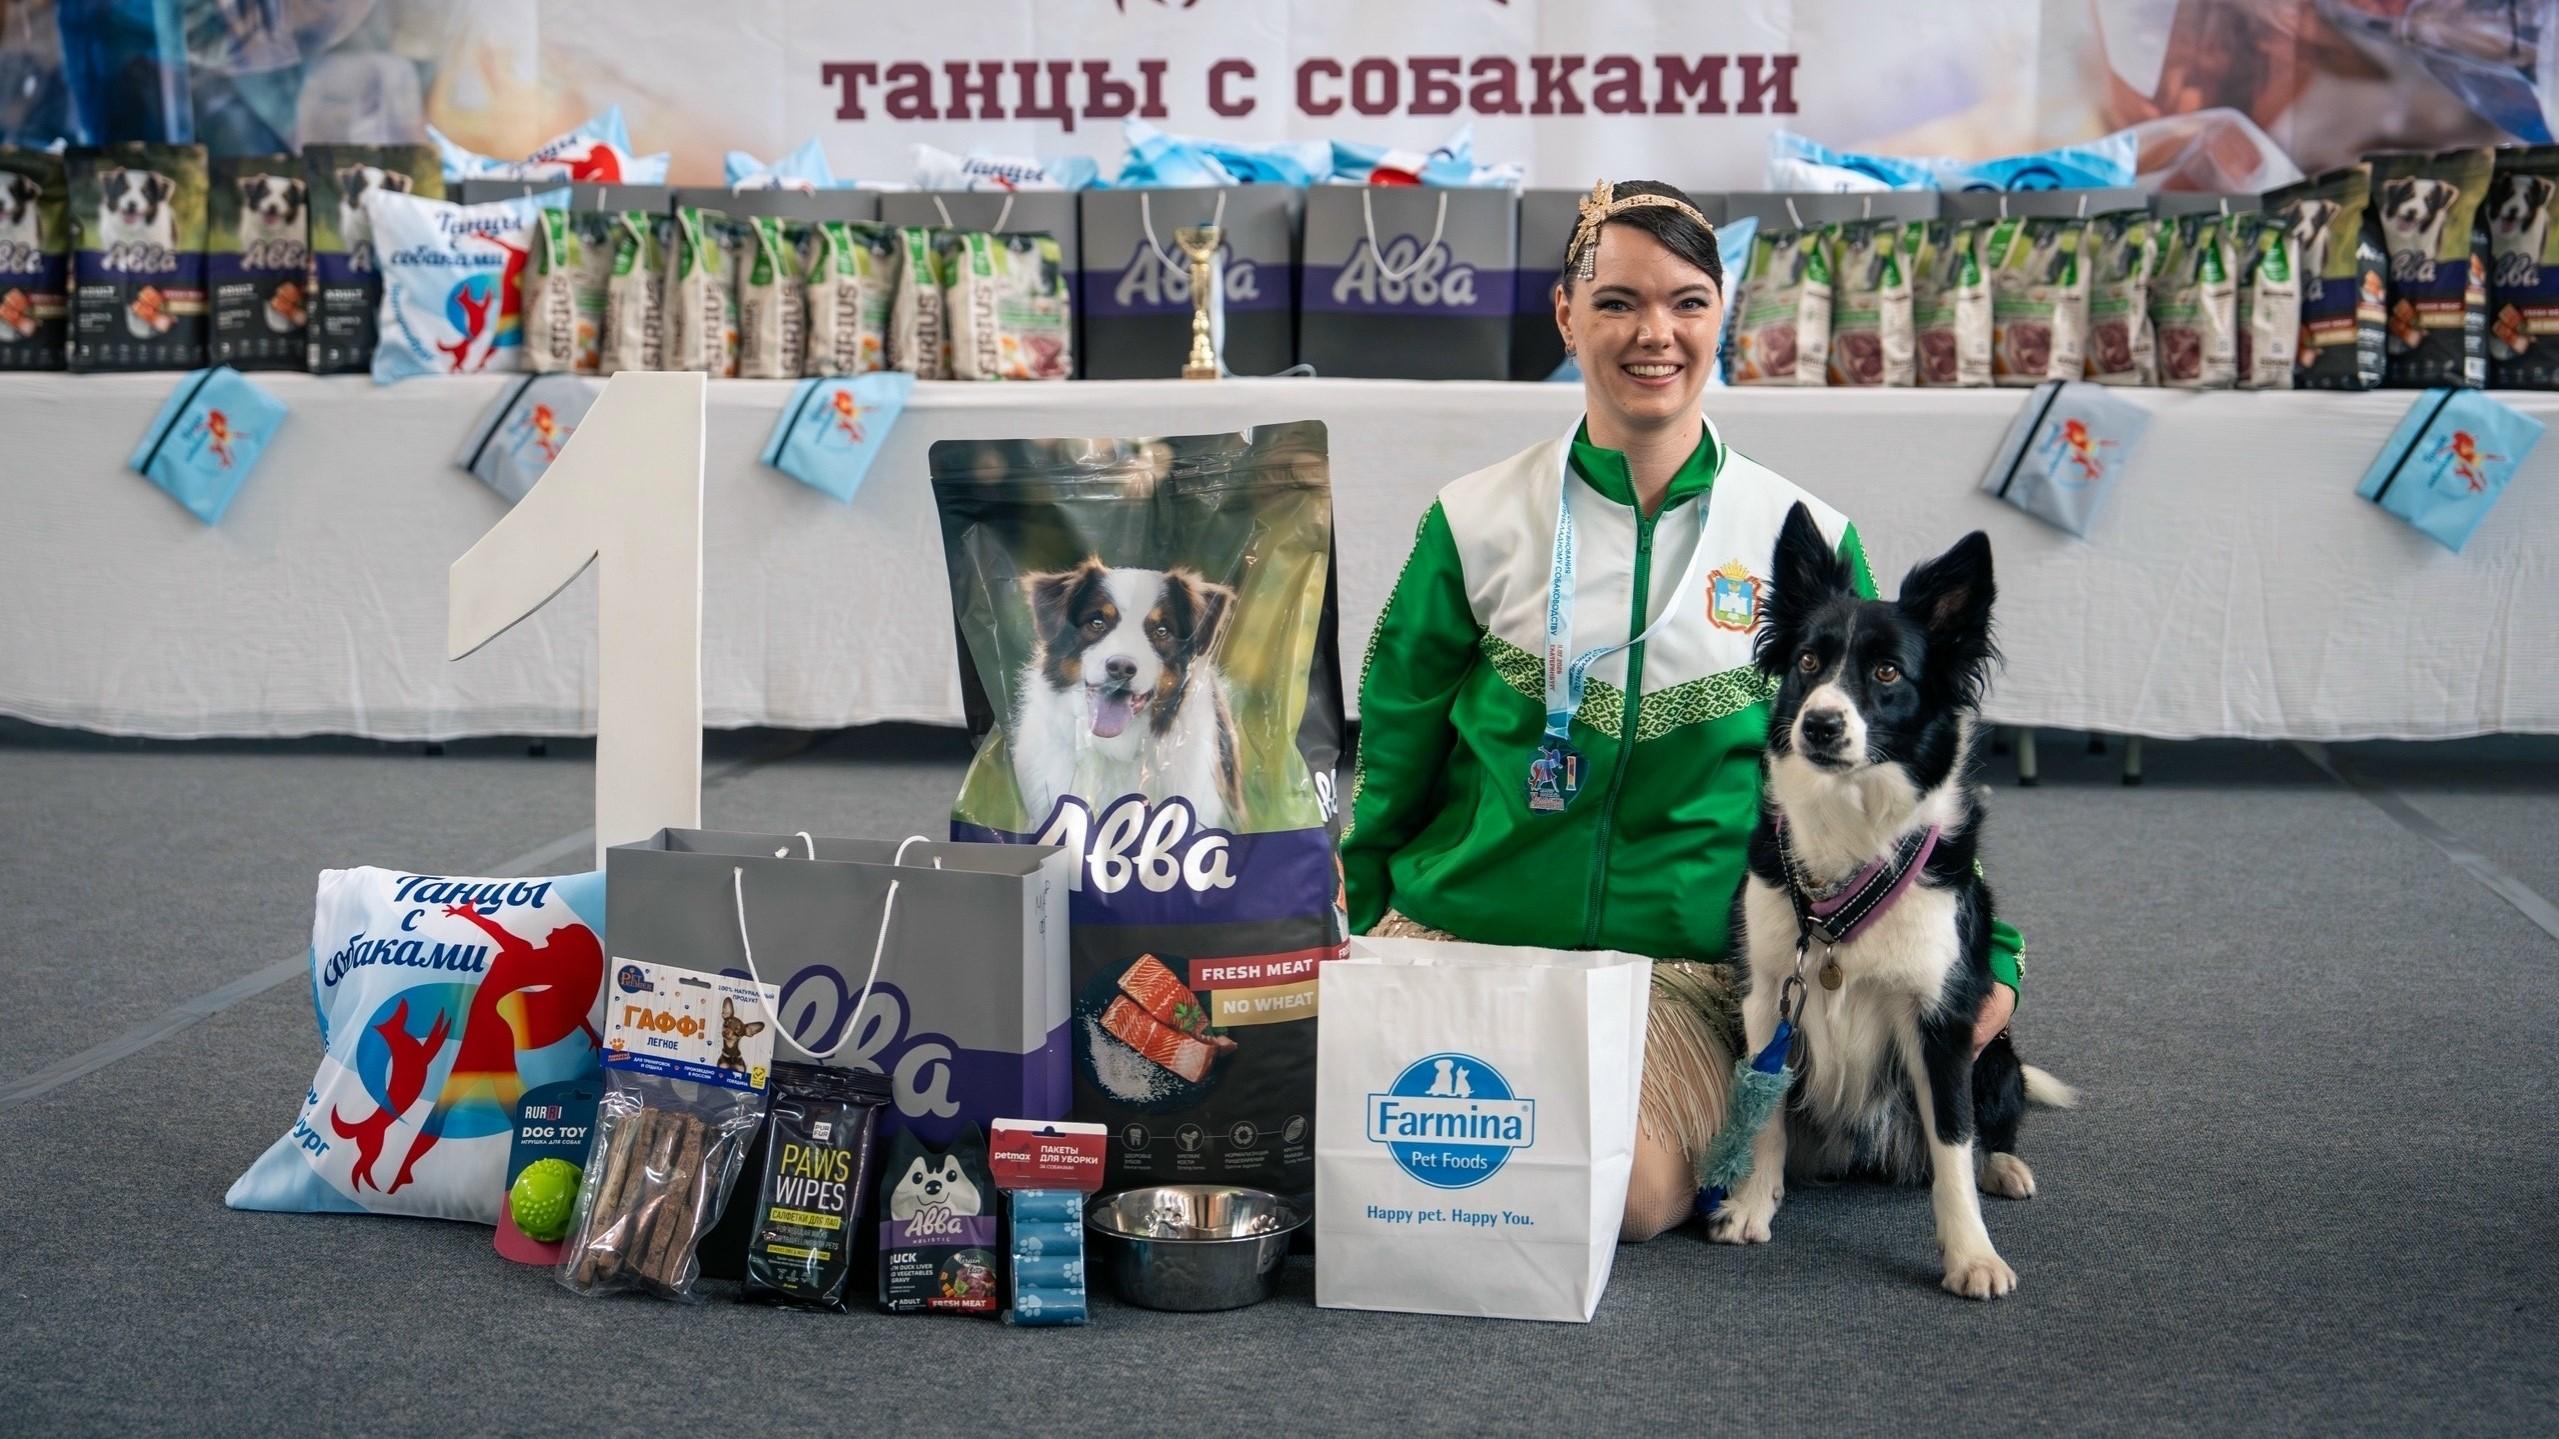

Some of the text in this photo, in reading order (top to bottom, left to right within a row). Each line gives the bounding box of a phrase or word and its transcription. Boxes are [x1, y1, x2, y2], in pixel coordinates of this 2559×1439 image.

[435, 212, 522, 234] Танцы
[391, 246, 505, 267] собаками
[1550, 566, 1563, 636] СОБАКОВОДСТВУ
[395, 875, 552, 917] Танцы
[401, 908, 426, 932] с
[323, 931, 489, 988] собаками
[1202, 958, 1314, 982] FRESH MEAT
[732, 993, 758, 1004] ПРОДУКТ
[1223, 991, 1315, 1015] NO WHEAT
[623, 1004, 706, 1040] ГАФФ!
[646, 1036, 679, 1051] ЛЕГКОЕ
[522, 1126, 588, 1138] DOG TOY
[1379, 1101, 1523, 1141] Farmina
[994, 1151, 1032, 1162] petmax
[1040, 1145, 1079, 1155] ПАКЕТЫ
[1040, 1154, 1099, 1164] ДЛЯ УБОРКИ
[1411, 1151, 1489, 1170] Pet Foods
[780, 1143, 852, 1182] PAWS
[775, 1175, 846, 1212] WIPES
[772, 1210, 839, 1227] САЛФЕТКИ ДЛЯ ЛАП
[1367, 1205, 1535, 1228] Happy pet. Happy You.
[932, 1300, 960, 1308] FRESH
[962, 1299, 987, 1307] MEAT
